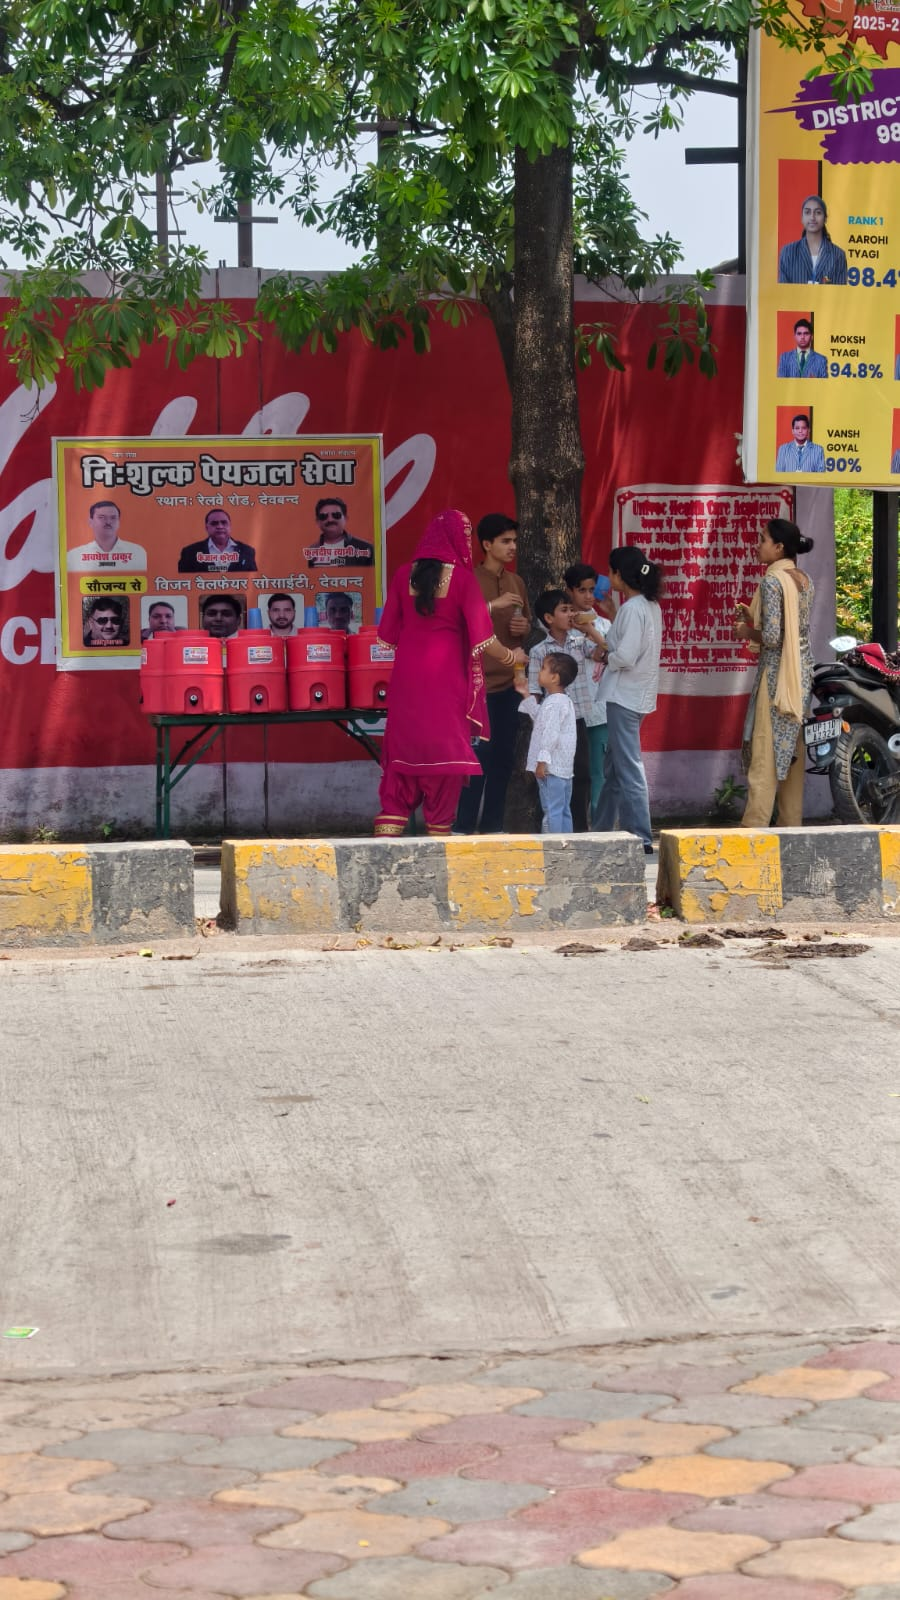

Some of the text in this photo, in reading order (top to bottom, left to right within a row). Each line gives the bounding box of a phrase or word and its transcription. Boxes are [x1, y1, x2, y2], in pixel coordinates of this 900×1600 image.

[848, 216, 884, 226] RANK 1
[848, 234, 889, 245] AAROHI
[848, 249, 879, 259] TYAGI
[848, 266, 900, 288] 98.4
[830, 335, 866, 345] MOKSH
[830, 348, 859, 358] TYAGI
[830, 362, 883, 379] 94.8%
[827, 429, 860, 439] VANSH
[827, 443, 859, 453] GOYAL
[199, 453, 297, 486] पेयजल
[300, 453, 356, 485] सेवा
[826, 457, 862, 473] 90%
[197, 494, 223, 507] रेलवे
[229, 494, 255, 507] रोड,
[258, 494, 299, 506] देवबन्द
[706, 500, 730, 515] Care
[304, 547, 331, 559] कुलदीप
[86, 579, 142, 593] सौजन्य से
[154, 577, 191, 591] विजन
[195, 576, 248, 591] वैलफेयर
[319, 575, 363, 589] देवबन्द
